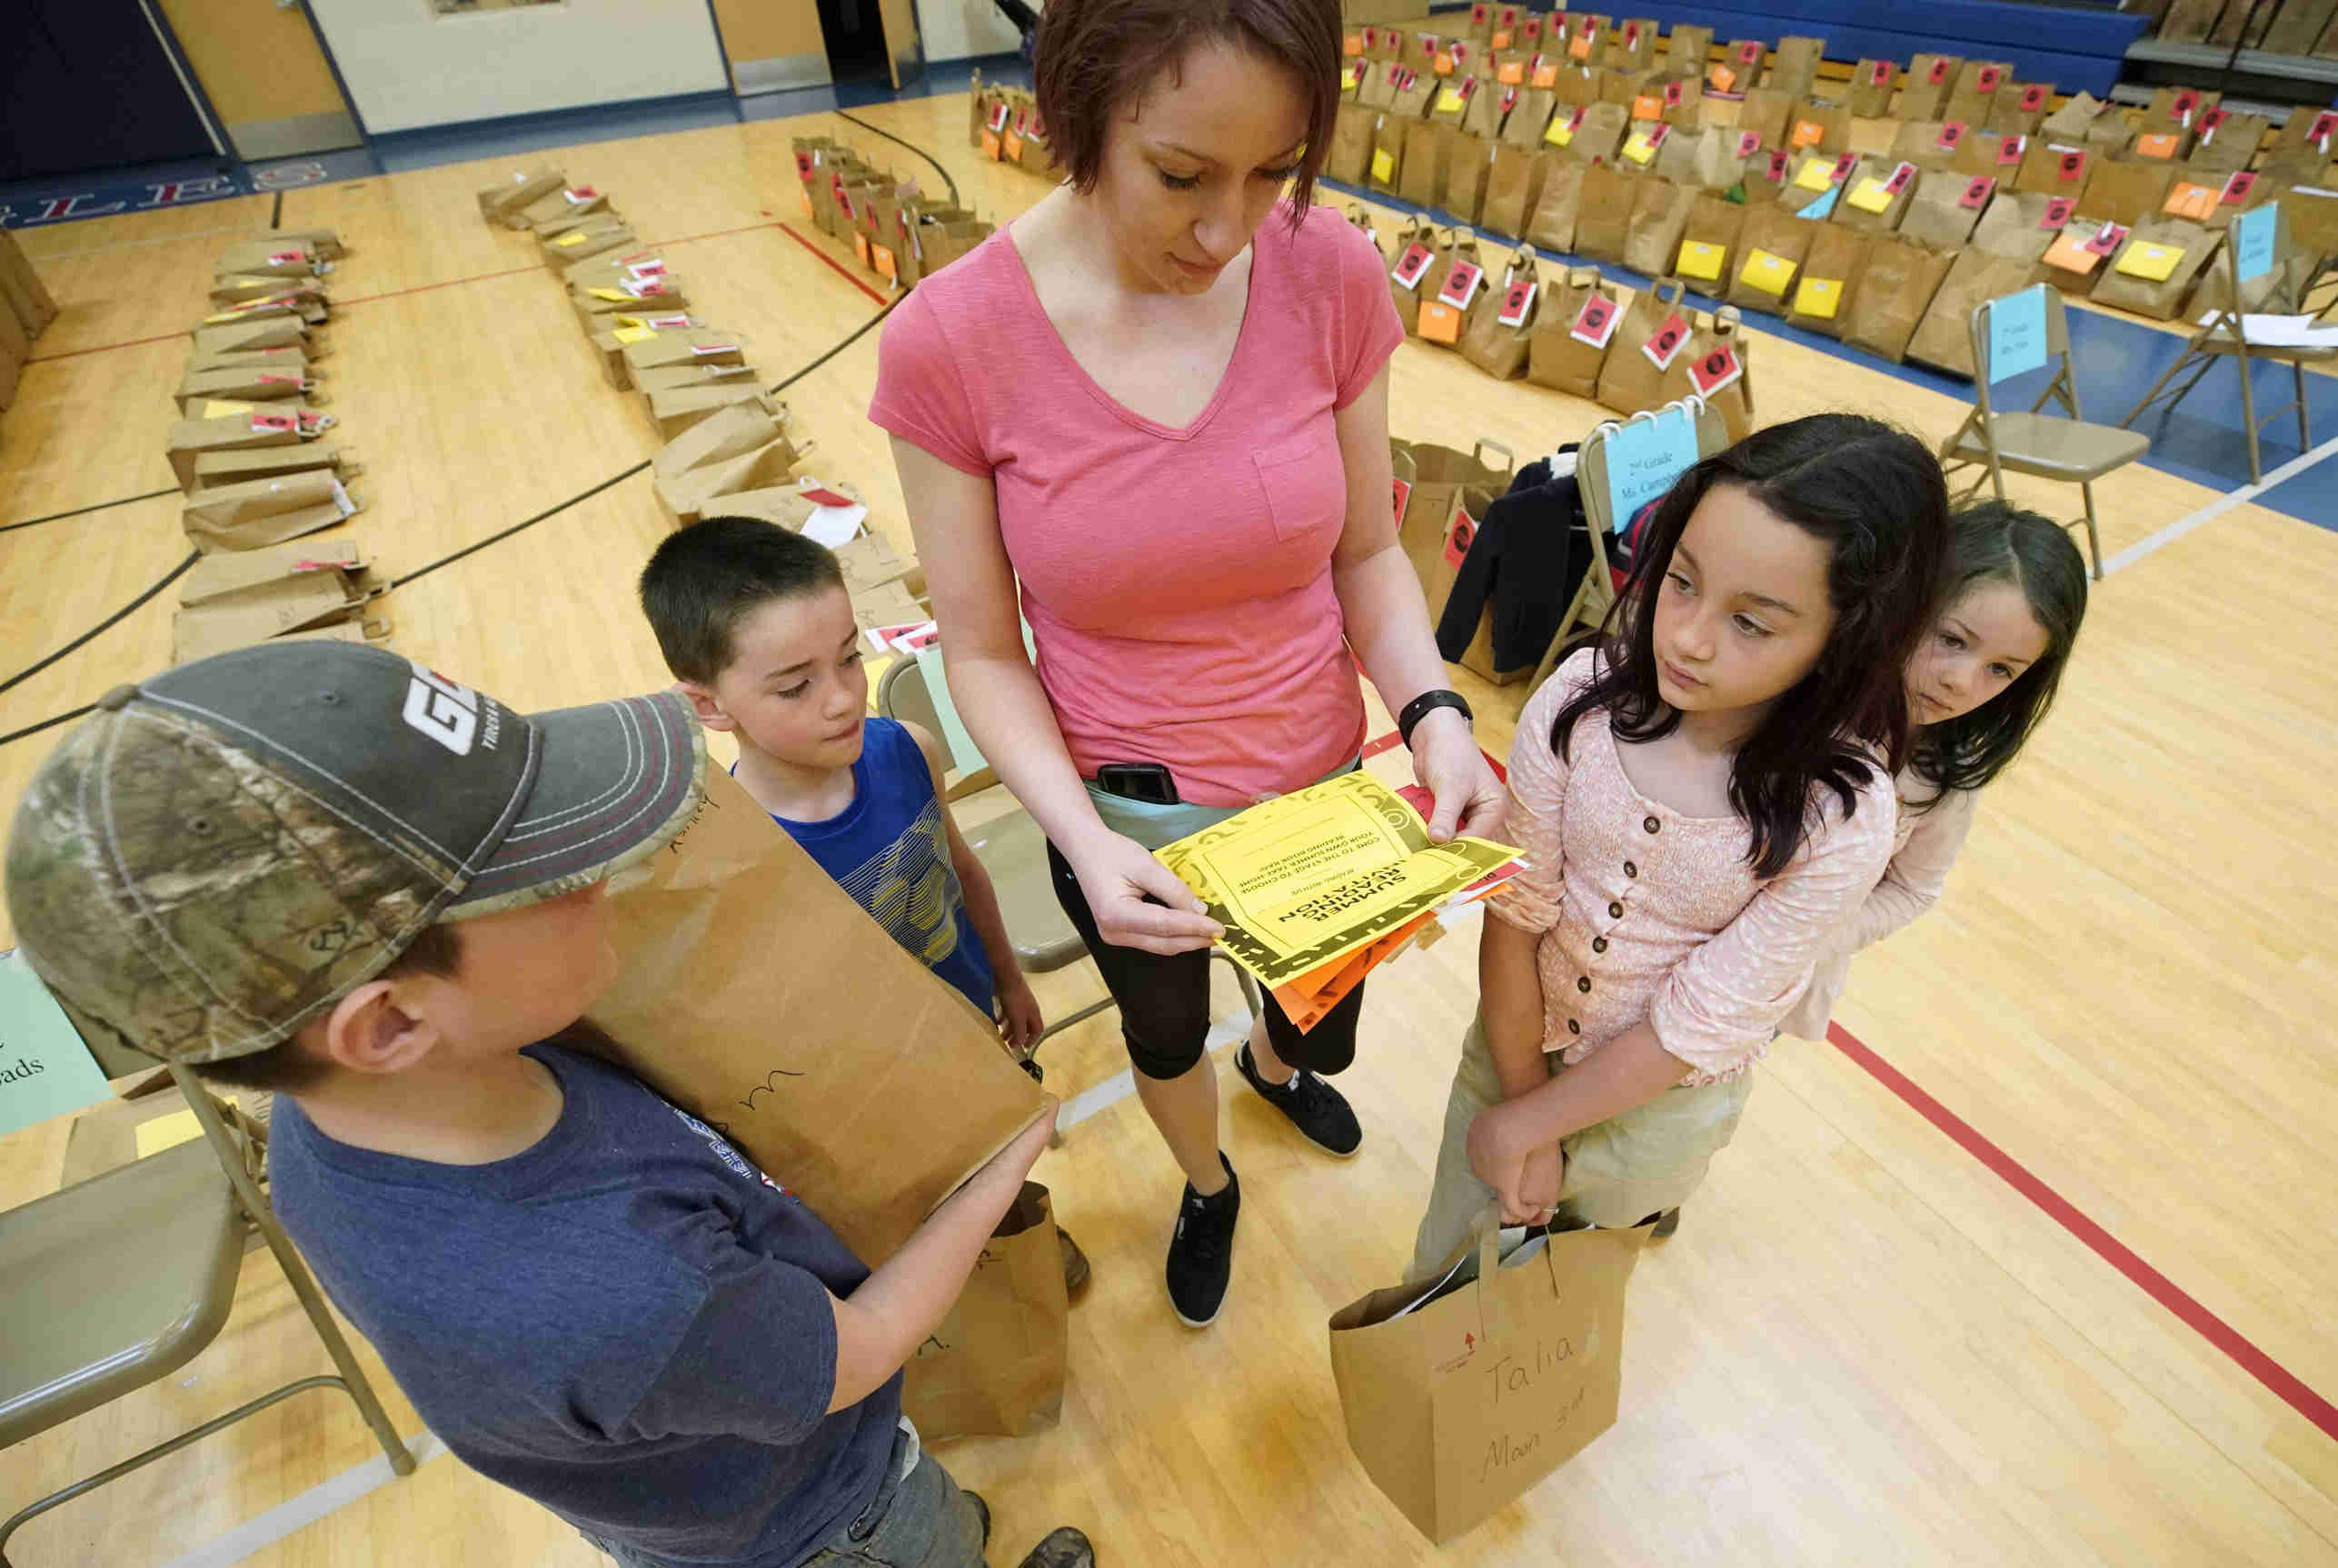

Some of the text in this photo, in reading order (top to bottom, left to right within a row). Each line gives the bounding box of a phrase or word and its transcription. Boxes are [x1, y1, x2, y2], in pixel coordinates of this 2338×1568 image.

[1302, 868, 1400, 918] READING
[1314, 875, 1407, 922] SUMMER
[1483, 1337, 1575, 1404] Talia
